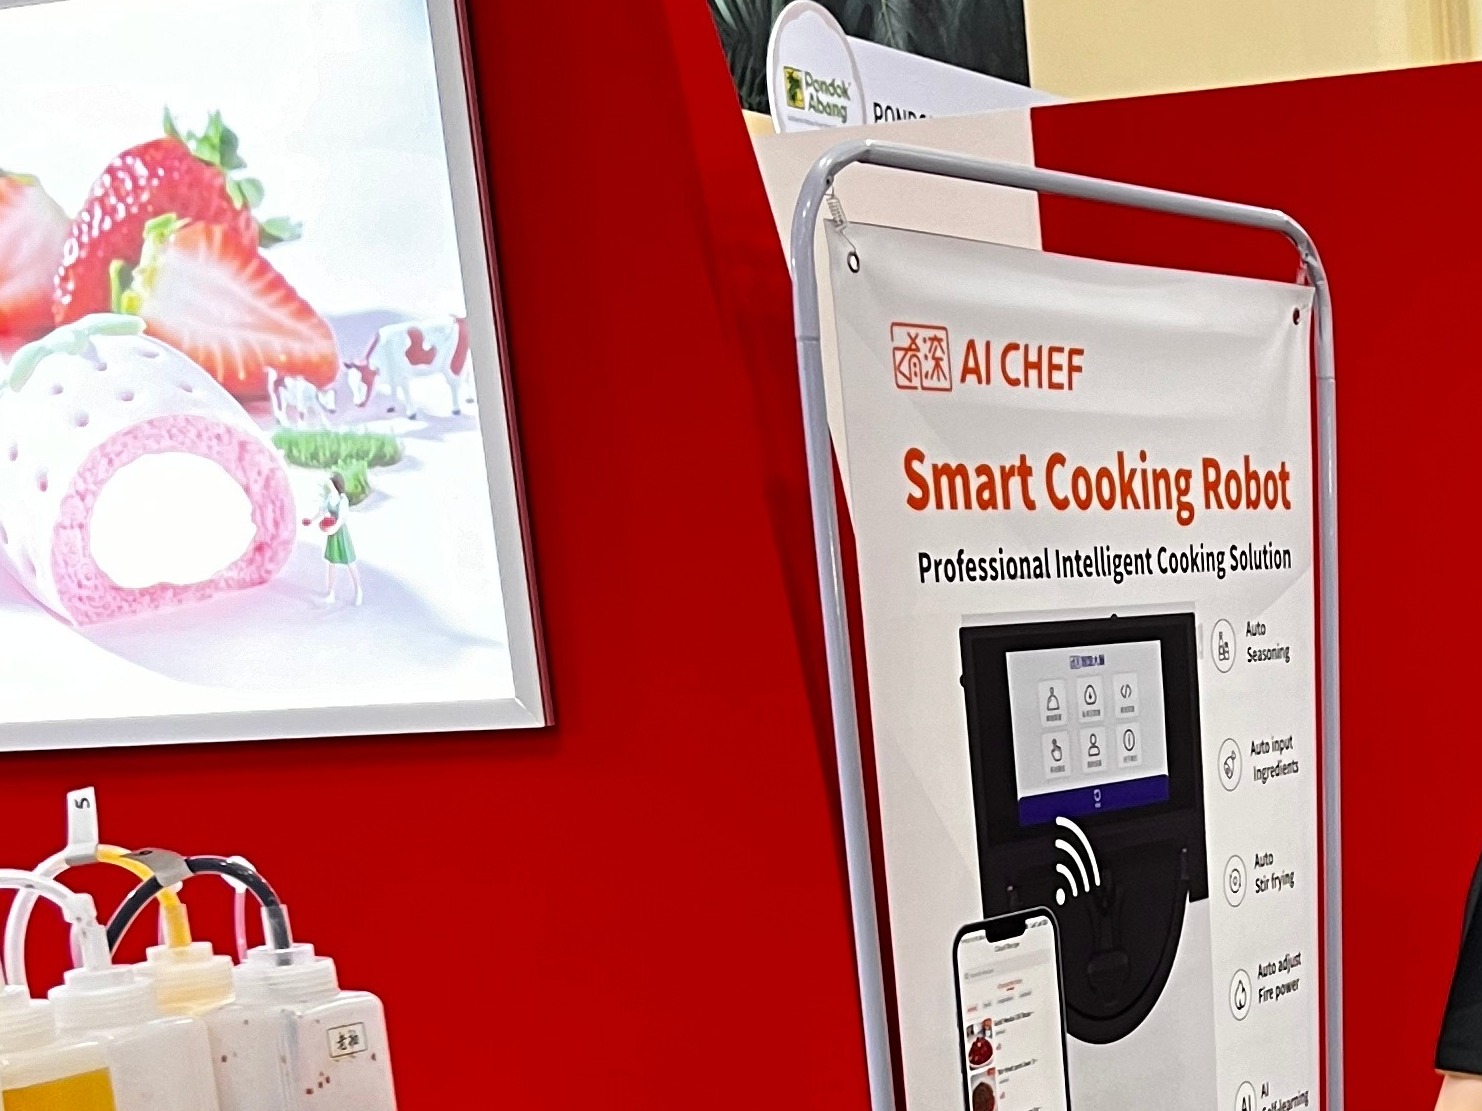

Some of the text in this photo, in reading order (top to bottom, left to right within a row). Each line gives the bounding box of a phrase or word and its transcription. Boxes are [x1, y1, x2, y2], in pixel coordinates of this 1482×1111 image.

[804, 70, 851, 101] Pondok
[807, 93, 848, 124] Abang
[960, 339, 991, 385] AI
[1000, 342, 1085, 391] CHEF
[903, 447, 1292, 526] Smart Cooking Robot
[918, 541, 1292, 584] Professional Intelligent Cooking Solution
[1245, 620, 1267, 637] Auto
[1247, 642, 1290, 663] Seasoning
[1250, 735, 1293, 756] Auto input
[1253, 759, 1299, 784] Ingredients
[1254, 852, 1274, 869] Auto
[1255, 869, 1294, 894] Stir frying
[1257, 951, 1302, 979] Auto adjust
[1258, 977, 1300, 1004] Fire power
[1260, 1081, 1269, 1099] AI
